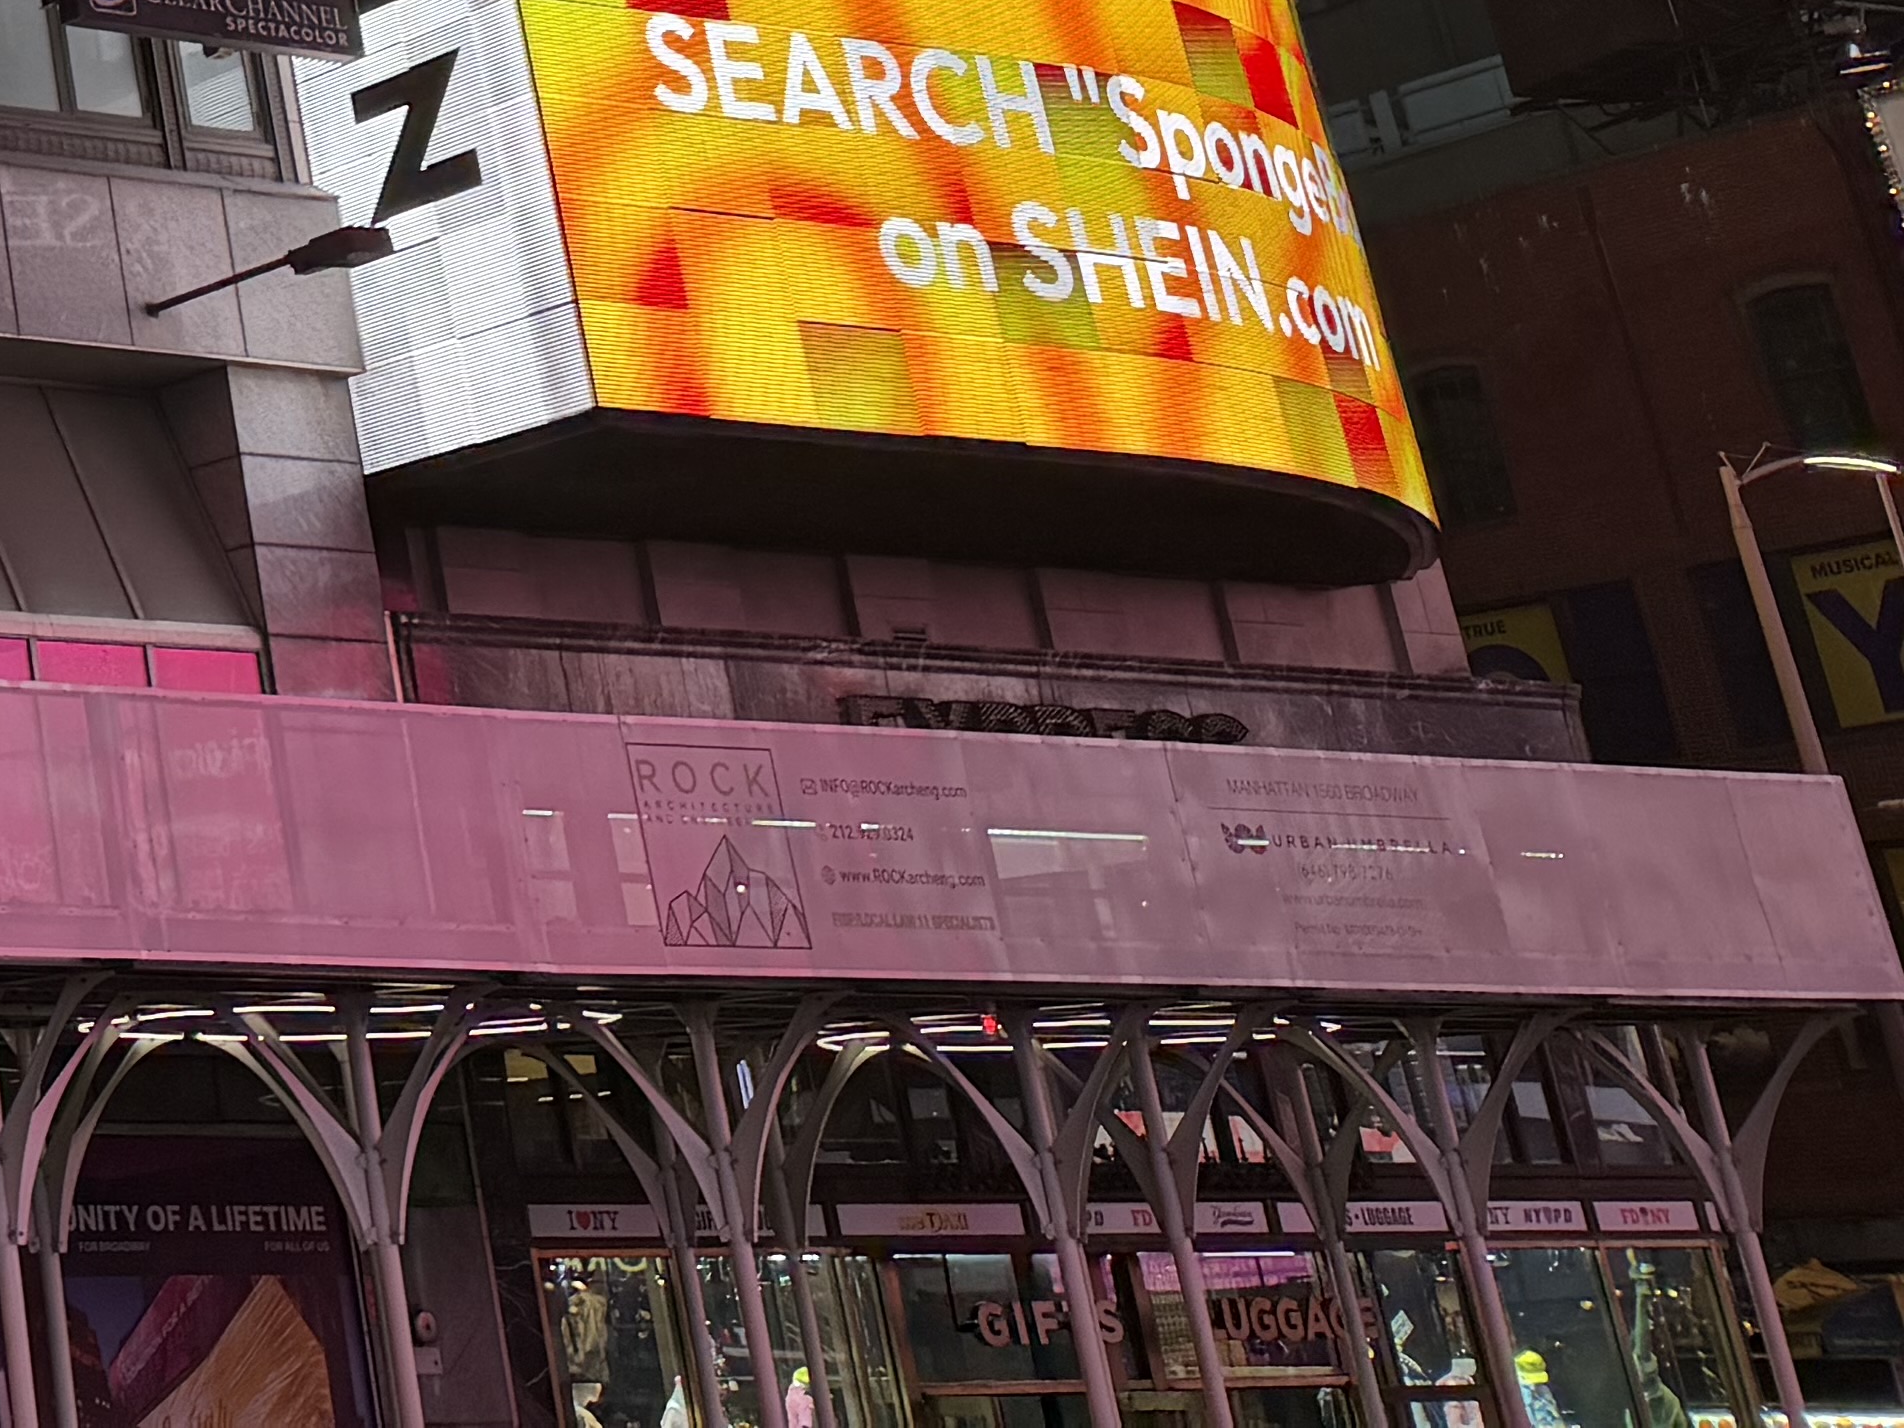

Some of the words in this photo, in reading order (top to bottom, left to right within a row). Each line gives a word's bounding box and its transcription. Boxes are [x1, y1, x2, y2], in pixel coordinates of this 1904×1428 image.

[225, 16, 349, 47] SPECTACOLOR
[646, 11, 1056, 154] SEARCH
[878, 212, 1001, 293] on
[1021, 200, 1382, 374] SHEIN.com
[1810, 552, 1900, 580] MUSICAL
[1463, 618, 1508, 642] TRUE
[635, 758, 772, 798] ROCK
[1226, 777, 1310, 799] MANHATTAN
[1345, 782, 1420, 804] BROADWAY
[1272, 834, 1338, 850] URBAN
[146, 1204, 181, 1233] OF
[188, 1204, 207, 1232] A
[210, 1204, 328, 1233] LIFETIME
[78, 1241, 98, 1253] FOR
[977, 1296, 1126, 1348] GIFS
